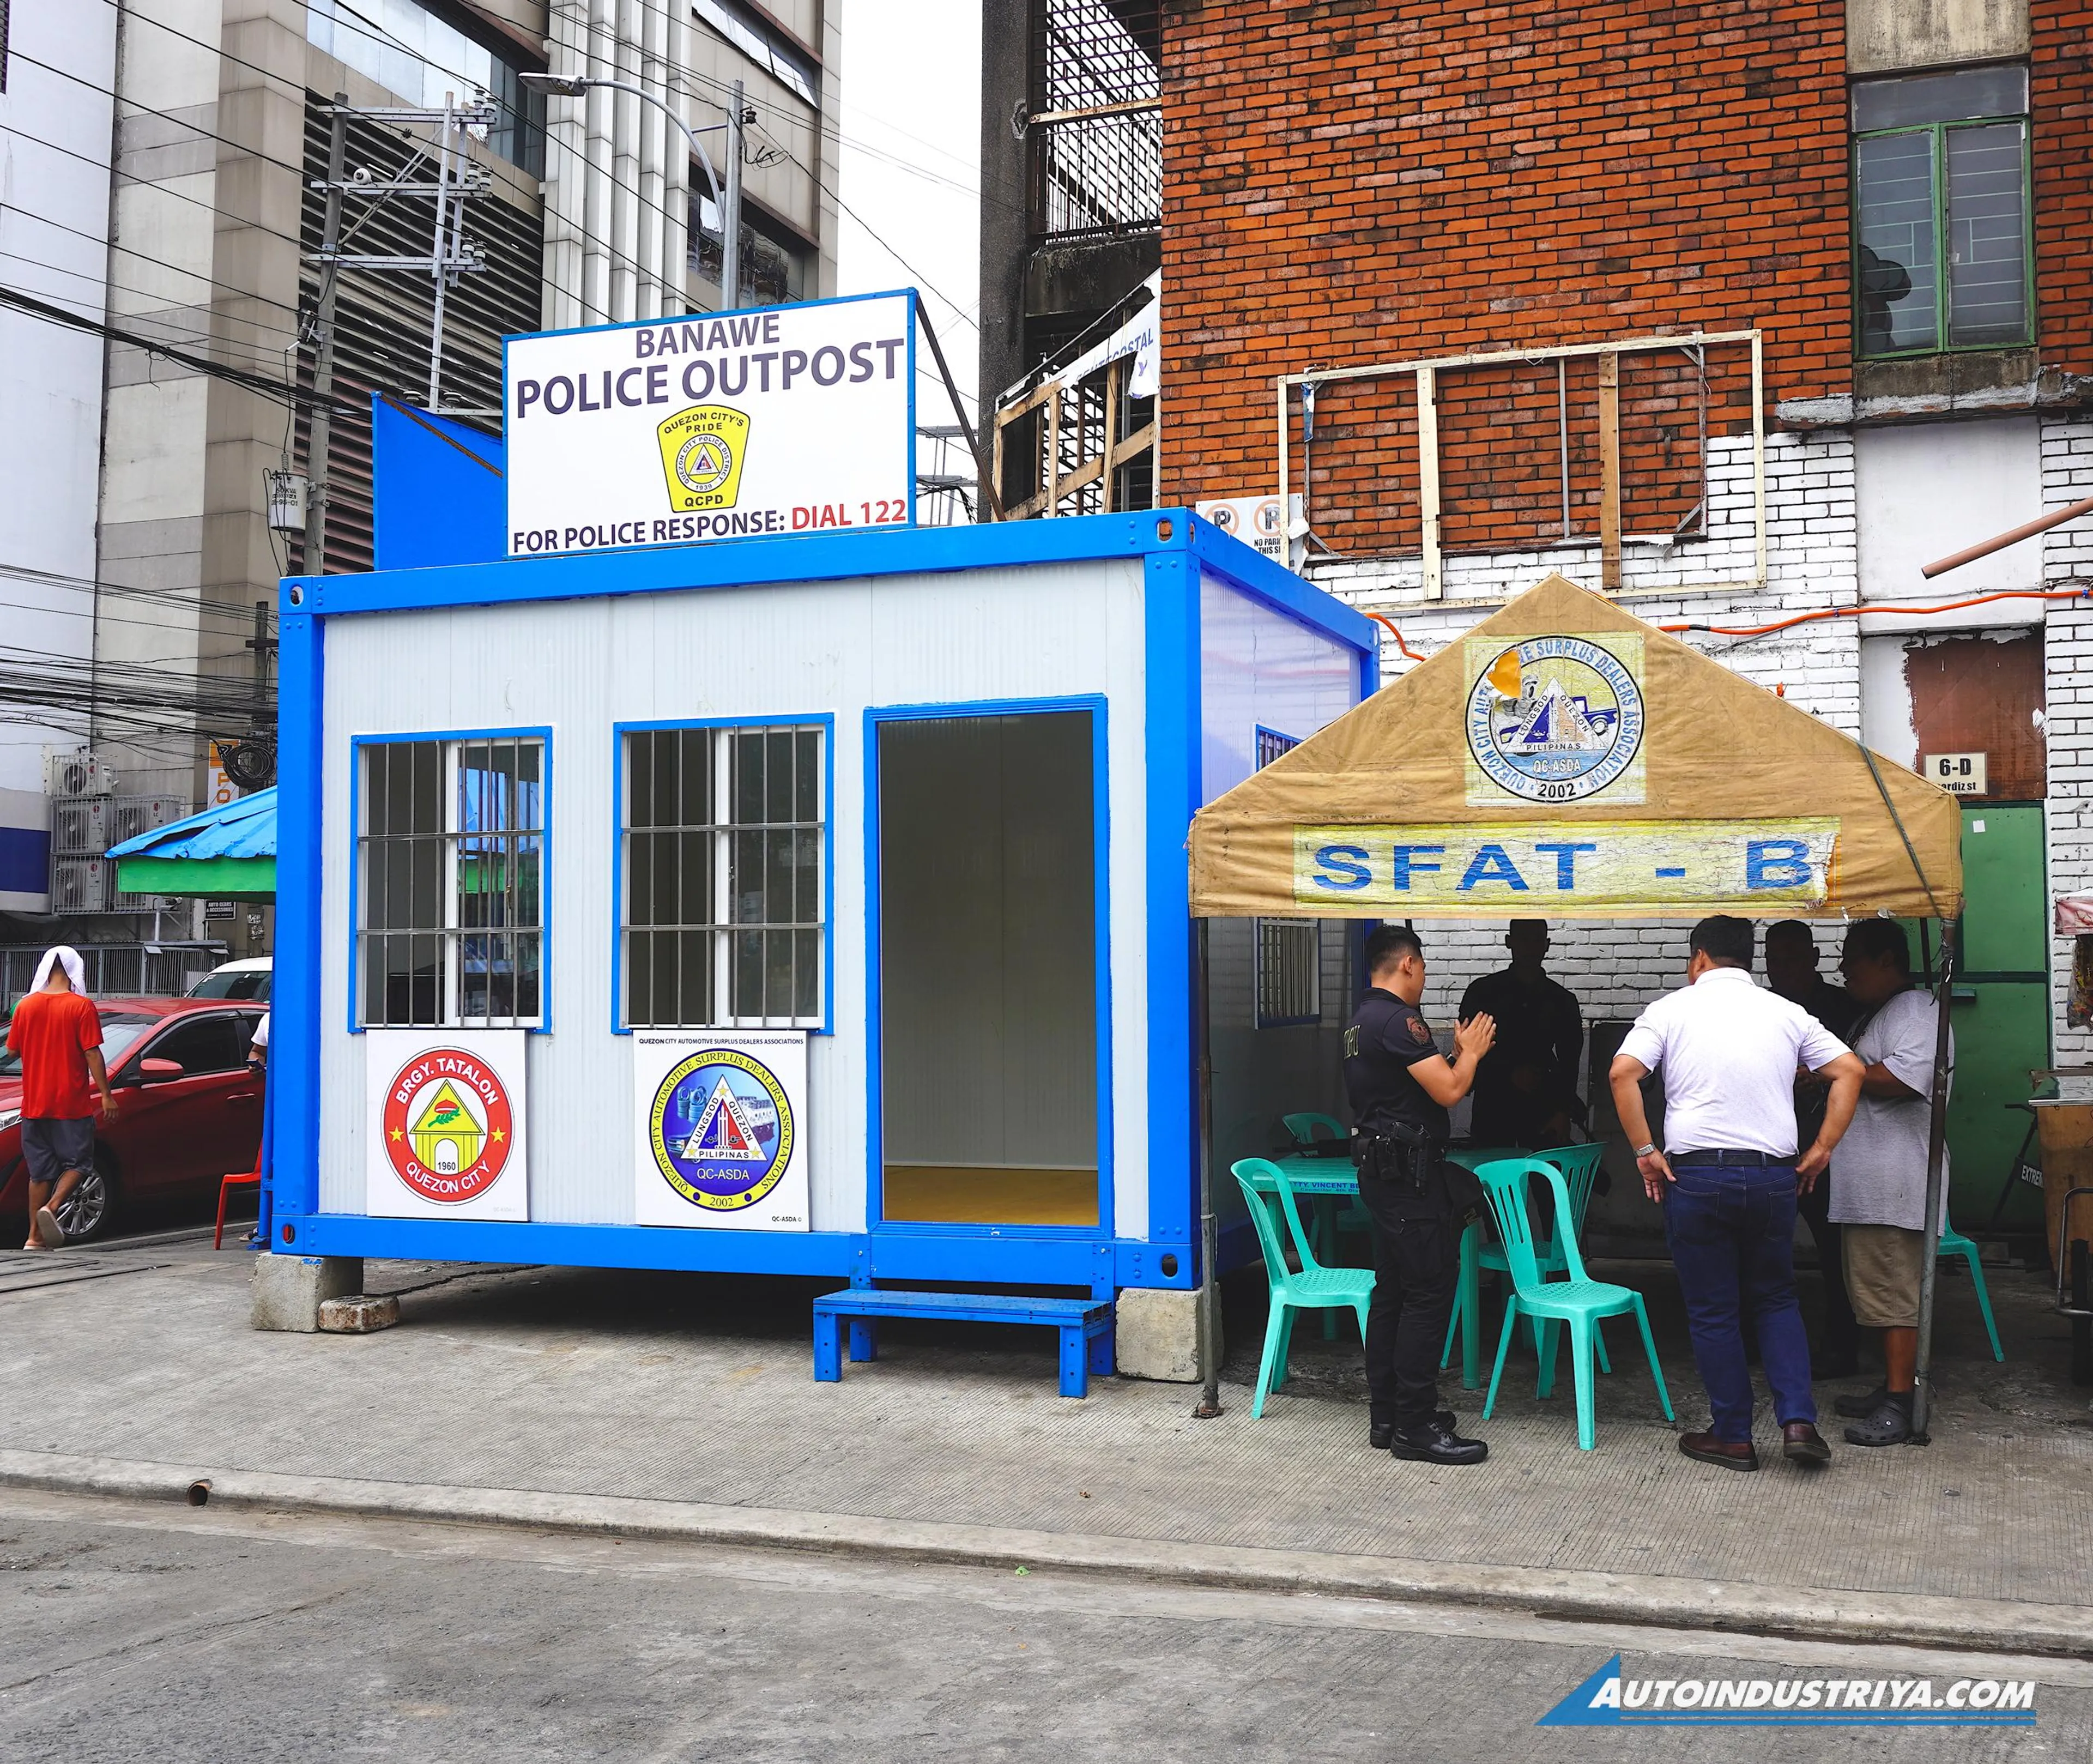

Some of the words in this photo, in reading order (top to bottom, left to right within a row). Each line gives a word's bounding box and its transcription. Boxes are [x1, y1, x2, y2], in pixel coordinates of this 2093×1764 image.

[637, 314, 780, 358] BANAWE
[518, 365, 669, 418] POLICE
[682, 338, 903, 400] OUTPOST
[664, 413, 707, 434] QUEZON
[711, 412, 744, 426] CITY'S
[686, 422, 723, 433] PRIDE
[683, 439, 697, 453] CITY
[699, 437, 724, 448] POLICE
[679, 455, 689, 484] QUEZON
[719, 448, 729, 481] DISTRICT
[685, 495, 723, 507] QCPD
[514, 528, 558, 553] FOR
[565, 522, 646, 548] POLICE
[654, 510, 785, 541] RESPONSE:
[793, 504, 852, 529] DIAL
[861, 499, 906, 524] 122
[1254, 539, 1263, 547] NO
[1536, 641, 1598, 663] SURPLUS
[1594, 655, 1636, 706] DEALERS
[1519, 694, 1548, 736] LUNGSOD
[1560, 695, 1589, 732] QUEZON
[1473, 720, 1491, 748] CITY
[1527, 742, 1581, 751] PILIPINAS
[1939, 758, 1971, 776] 6-D
[1538, 783, 1576, 798] 2002
[1313, 843, 1596, 891] SFAT
[1746, 841, 1811, 889] B
[695, 1052, 745, 1066] SURPLUS
[395, 1061, 435, 1104] BRGY.
[436, 1058, 499, 1105] TATALON
[654, 1060, 694, 1121] AUTOMOTIVE
[745, 1060, 783, 1103] DEALERS
[693, 1097, 719, 1144] LUNGSOD
[729, 1101, 753, 1141] QUEZON
[652, 1126, 662, 1151] CITY
[761, 1105, 791, 1189] ASSOCIATIONS
[438, 1162, 456, 1171] 1960
[699, 1150, 749, 1159] PILIPINAS
[406, 1162, 459, 1193] QUEZON
[461, 1160, 491, 1190] CITY
[658, 1152, 688, 1193] QUEZON
[697, 1168, 750, 1180] QC-ASDA
[709, 1197, 734, 1207] 2002
